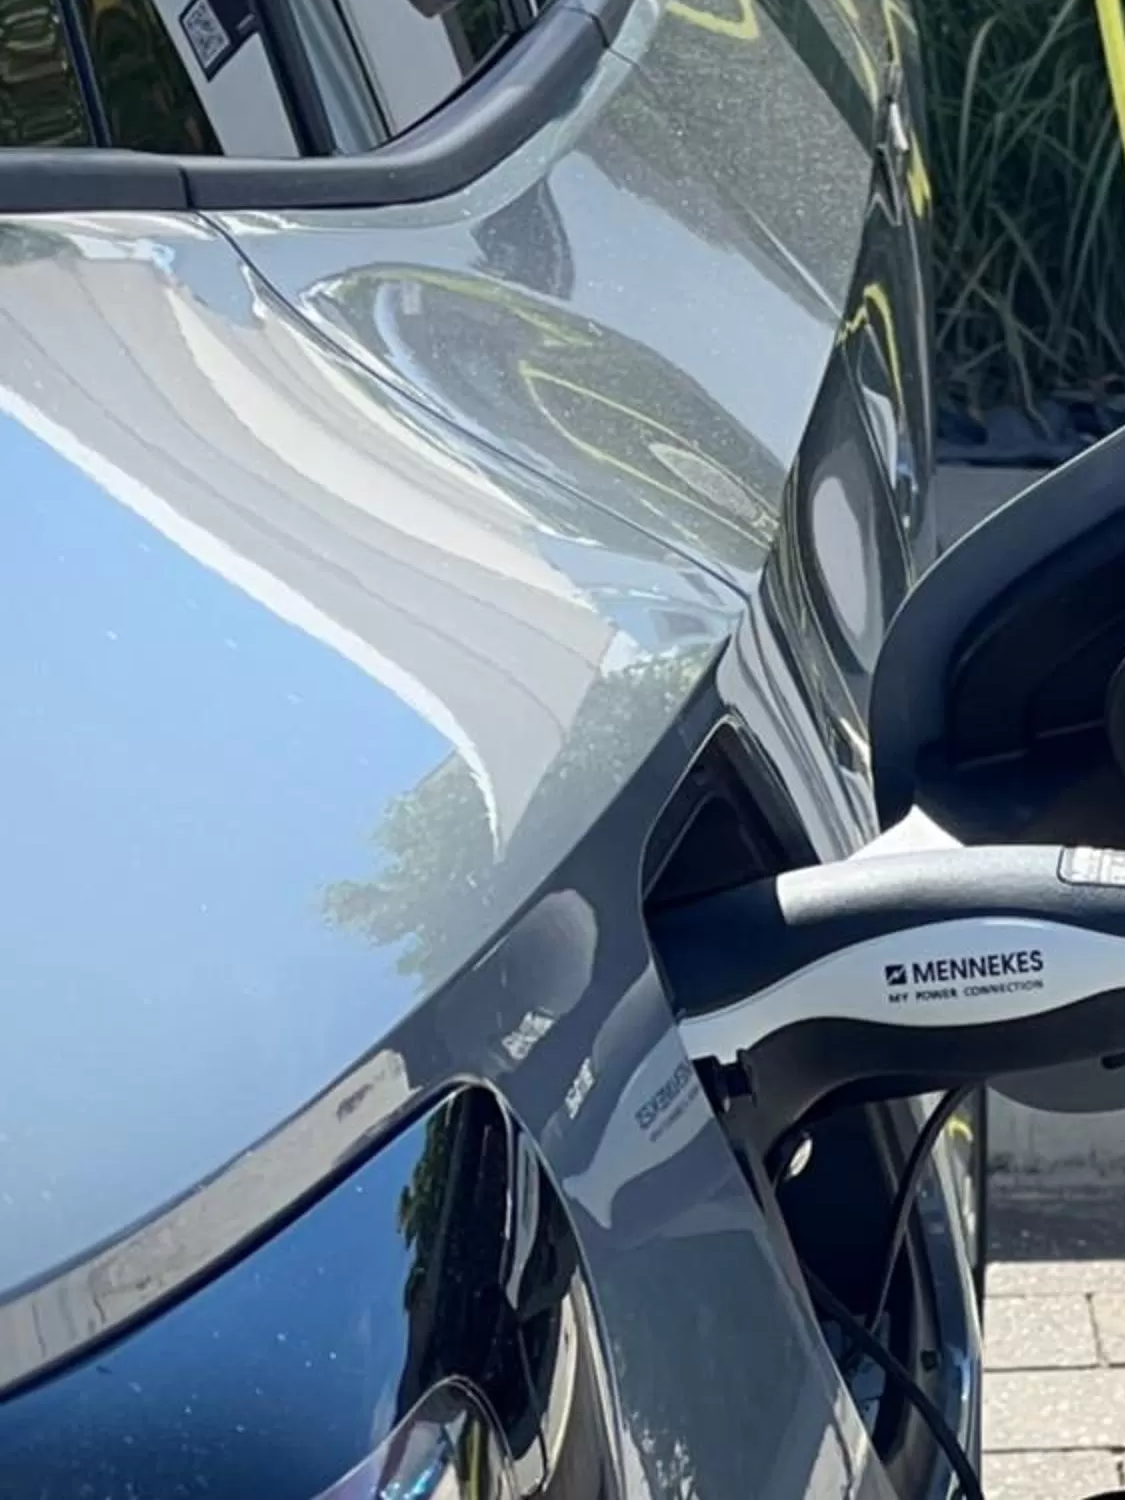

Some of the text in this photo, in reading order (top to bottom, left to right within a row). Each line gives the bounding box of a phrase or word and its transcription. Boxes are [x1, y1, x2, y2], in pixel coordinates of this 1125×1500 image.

[912, 950, 1044, 984] MENNEKES
[889, 980, 1044, 1003] MY POWER CONNECTION
